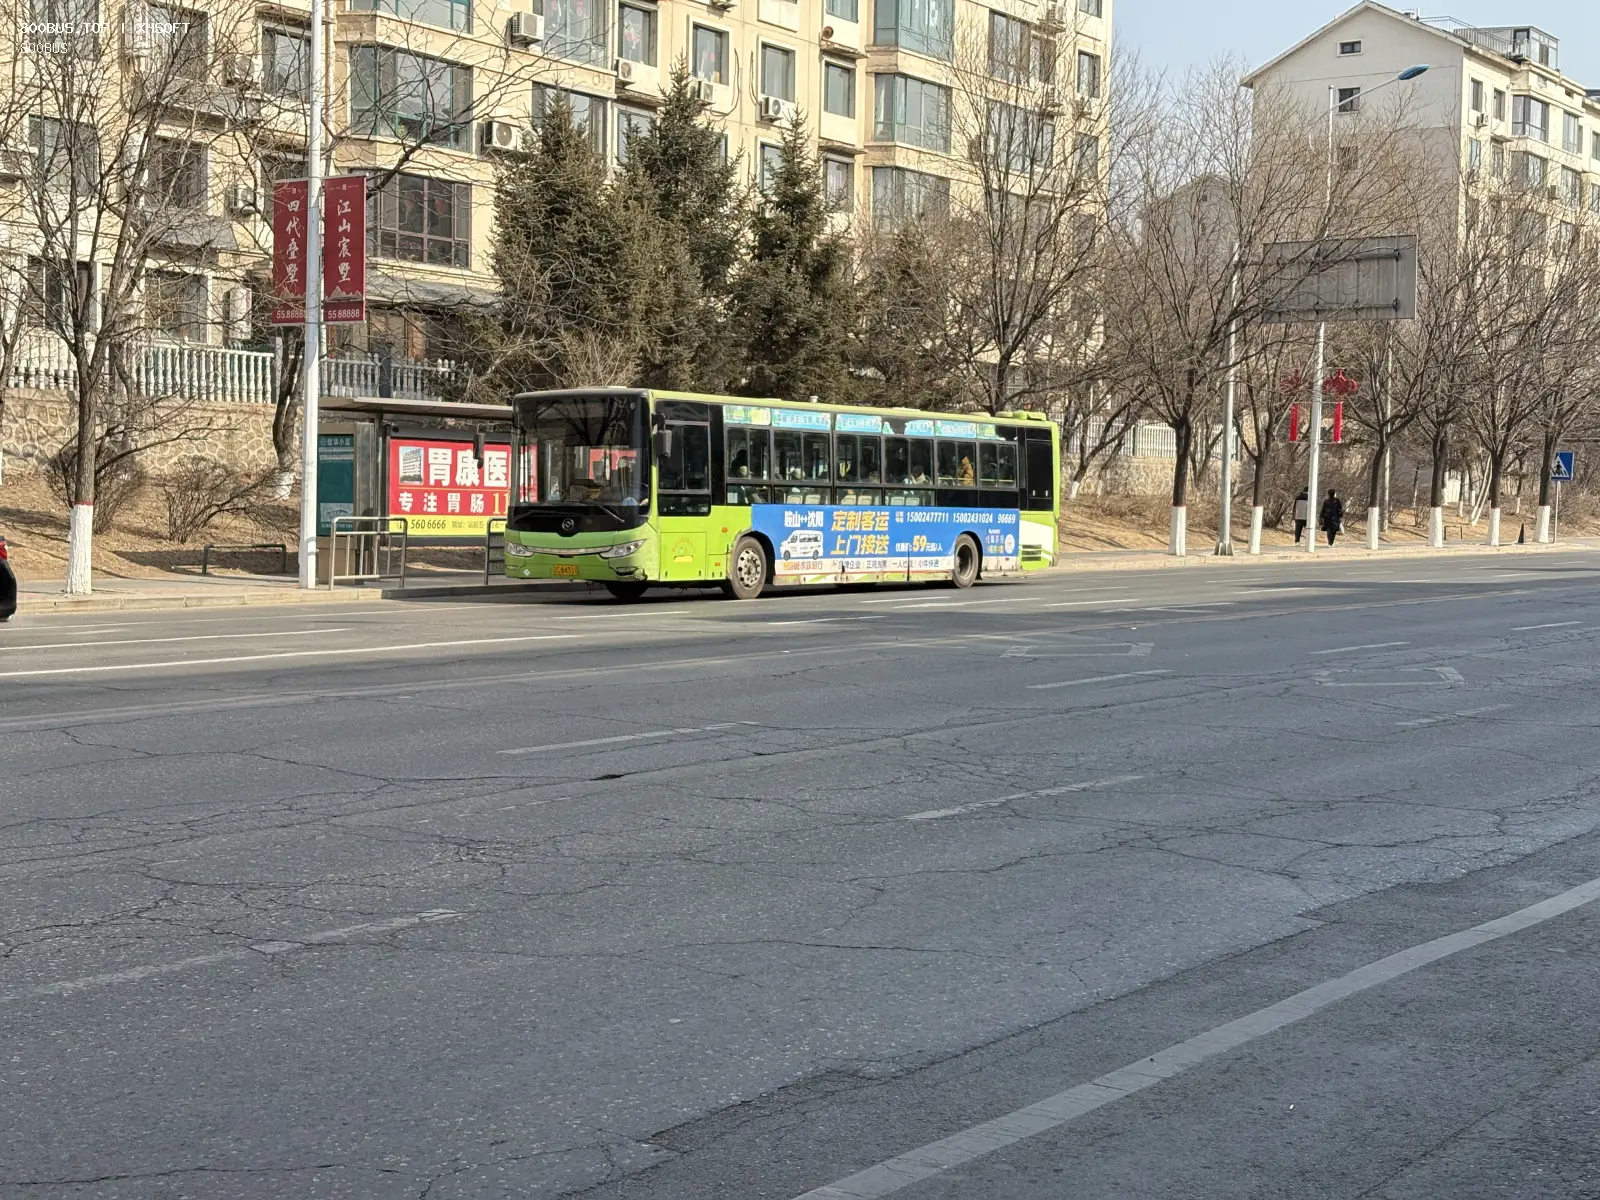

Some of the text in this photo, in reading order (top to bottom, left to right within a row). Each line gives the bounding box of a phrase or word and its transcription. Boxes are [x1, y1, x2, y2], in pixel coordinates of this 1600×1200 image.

[337, 199, 352, 283] 江山宸墅
[428, 447, 512, 487] 胃康医
[398, 491, 485, 513] 专注胃肠
[831, 510, 890, 532] 定制客运
[906, 511, 949, 523] 15002477711
[953, 512, 993, 524] 15002431024
[830, 534, 890, 555] 上门接送
